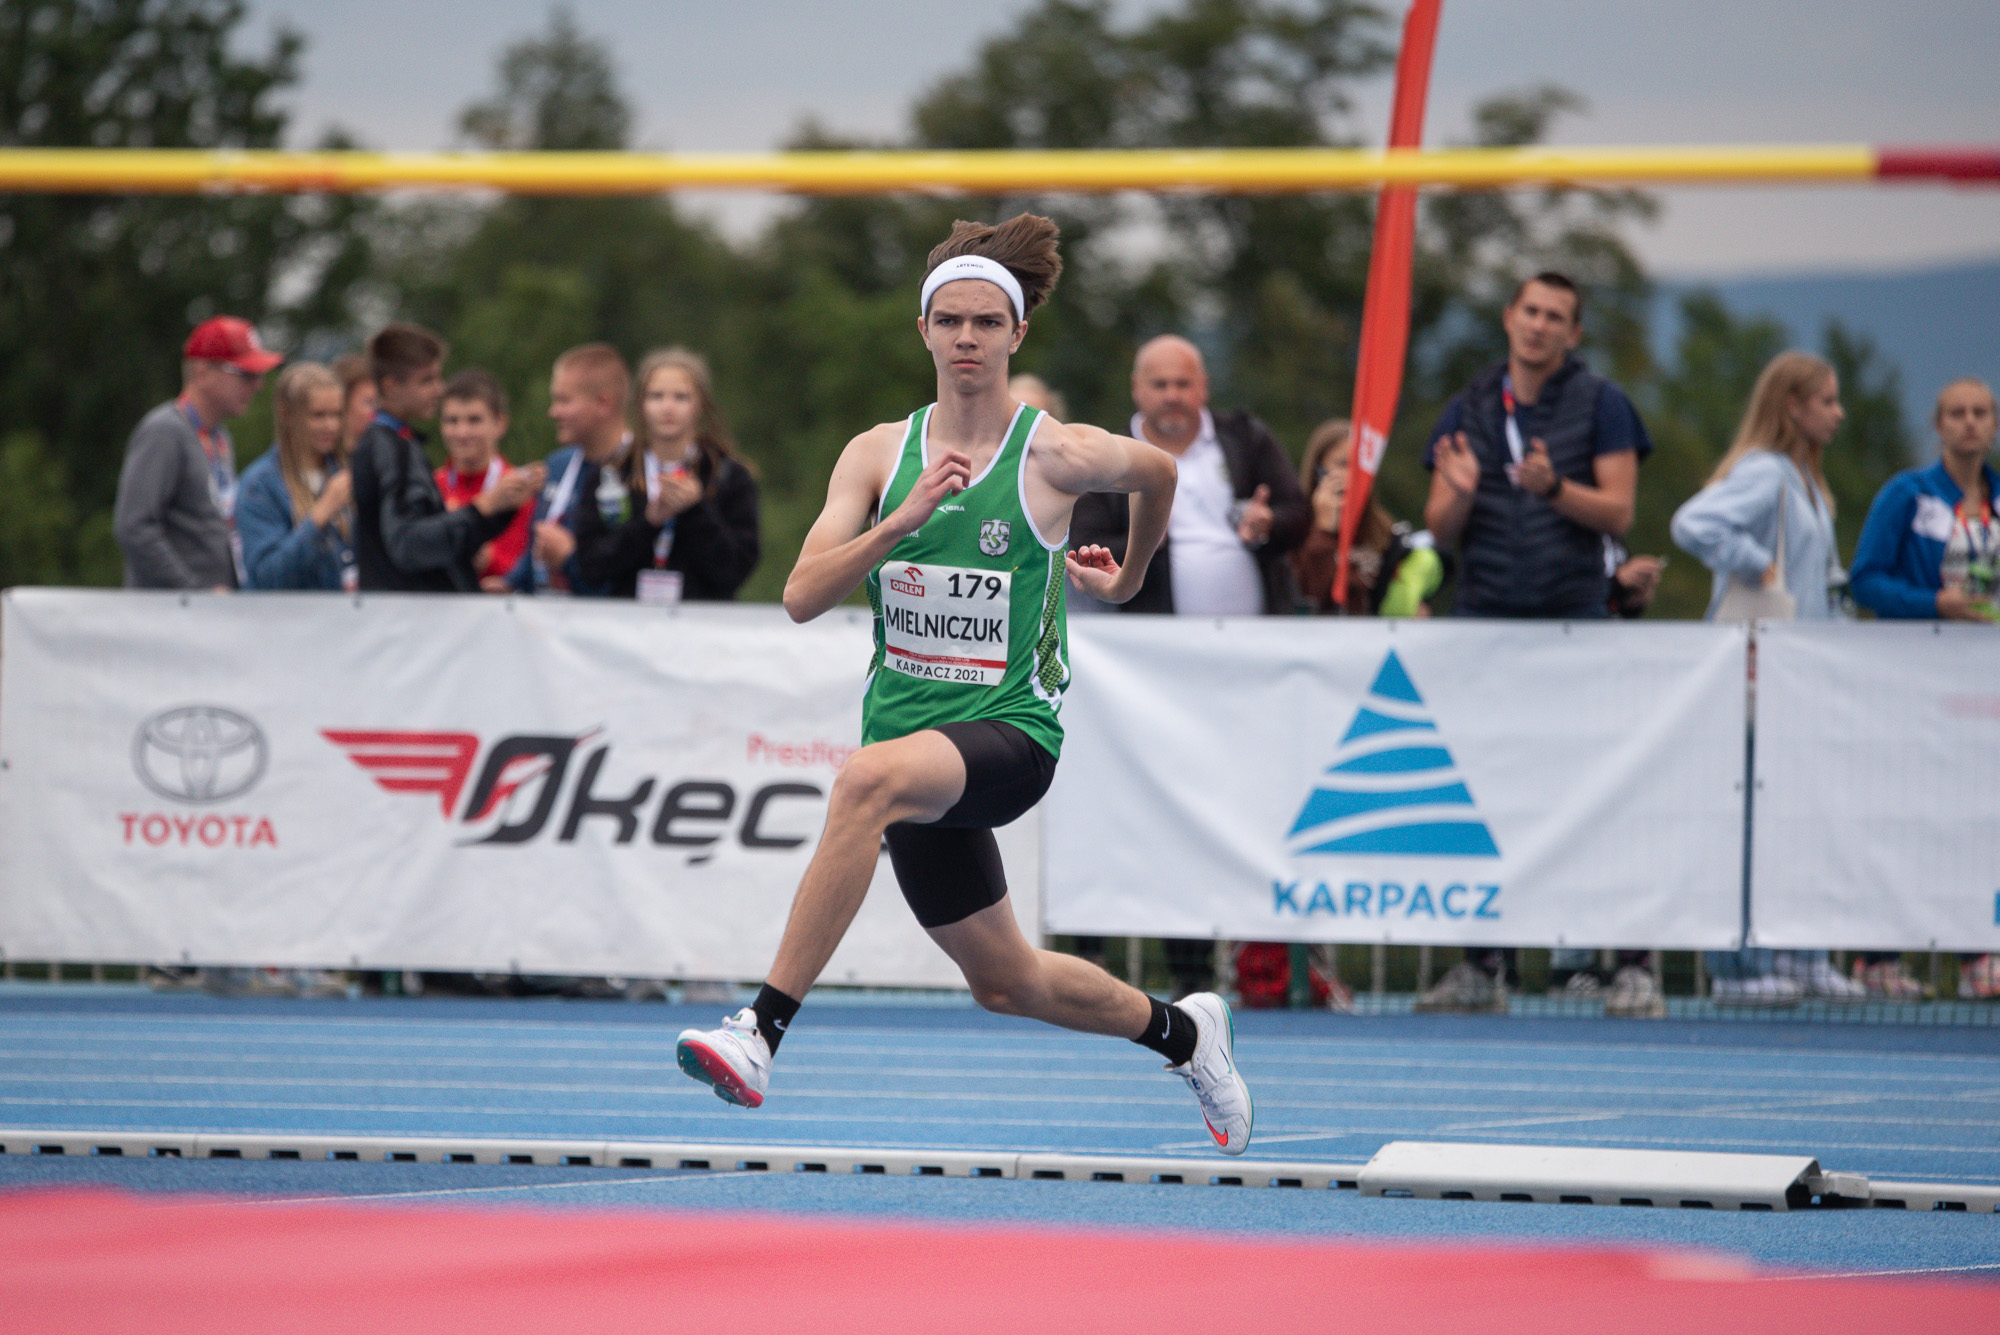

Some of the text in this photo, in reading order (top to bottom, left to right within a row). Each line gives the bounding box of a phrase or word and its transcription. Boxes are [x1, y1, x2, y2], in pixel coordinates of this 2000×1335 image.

[892, 582, 923, 596] ORLEN
[947, 573, 1002, 600] 179
[885, 605, 1003, 643] MIELNICZUK
[896, 658, 951, 679] KARPACZ
[954, 668, 985, 682] 2021
[120, 812, 279, 849] TOYOTA
[1273, 881, 1502, 920] KARPACZ
